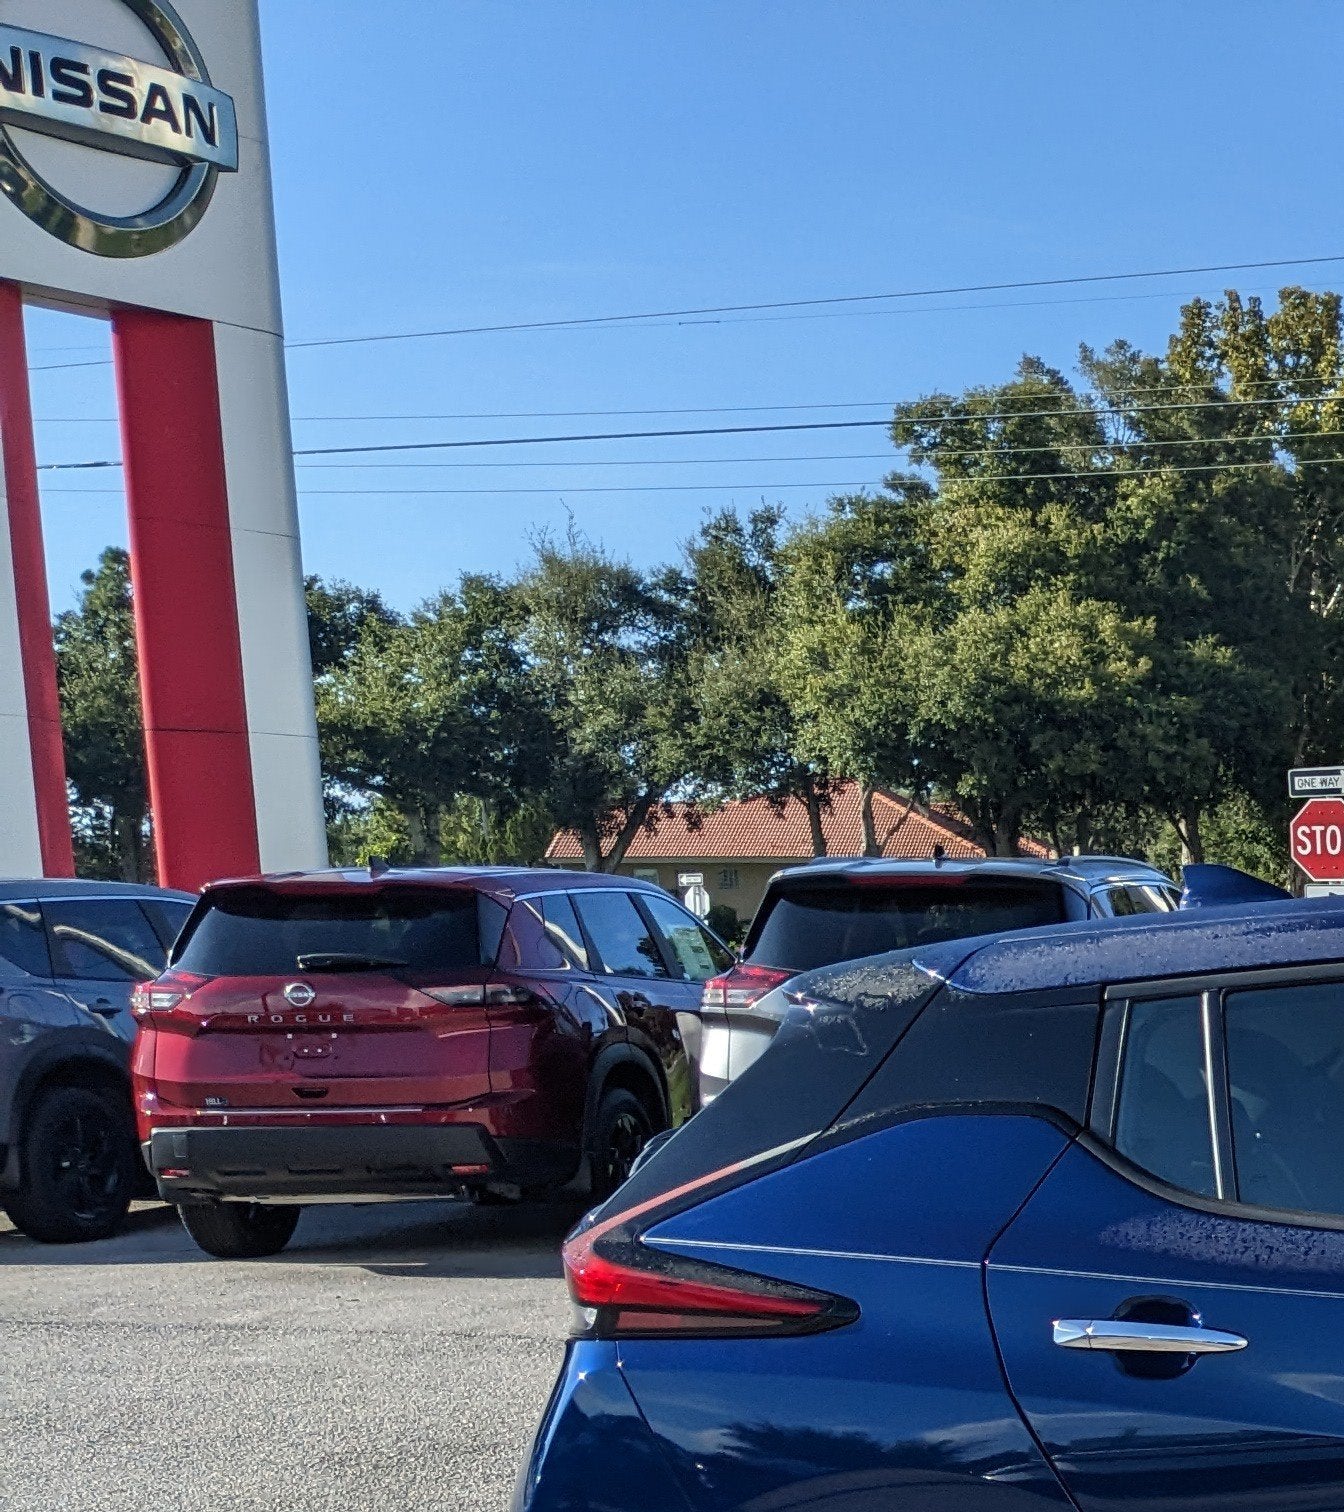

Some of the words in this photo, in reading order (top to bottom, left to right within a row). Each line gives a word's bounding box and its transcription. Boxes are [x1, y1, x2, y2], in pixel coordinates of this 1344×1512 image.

[0, 45, 220, 149] NISSAN
[1297, 777, 1317, 789] ONE
[1319, 776, 1340, 788] WAY
[247, 1013, 355, 1024] ROGUE
